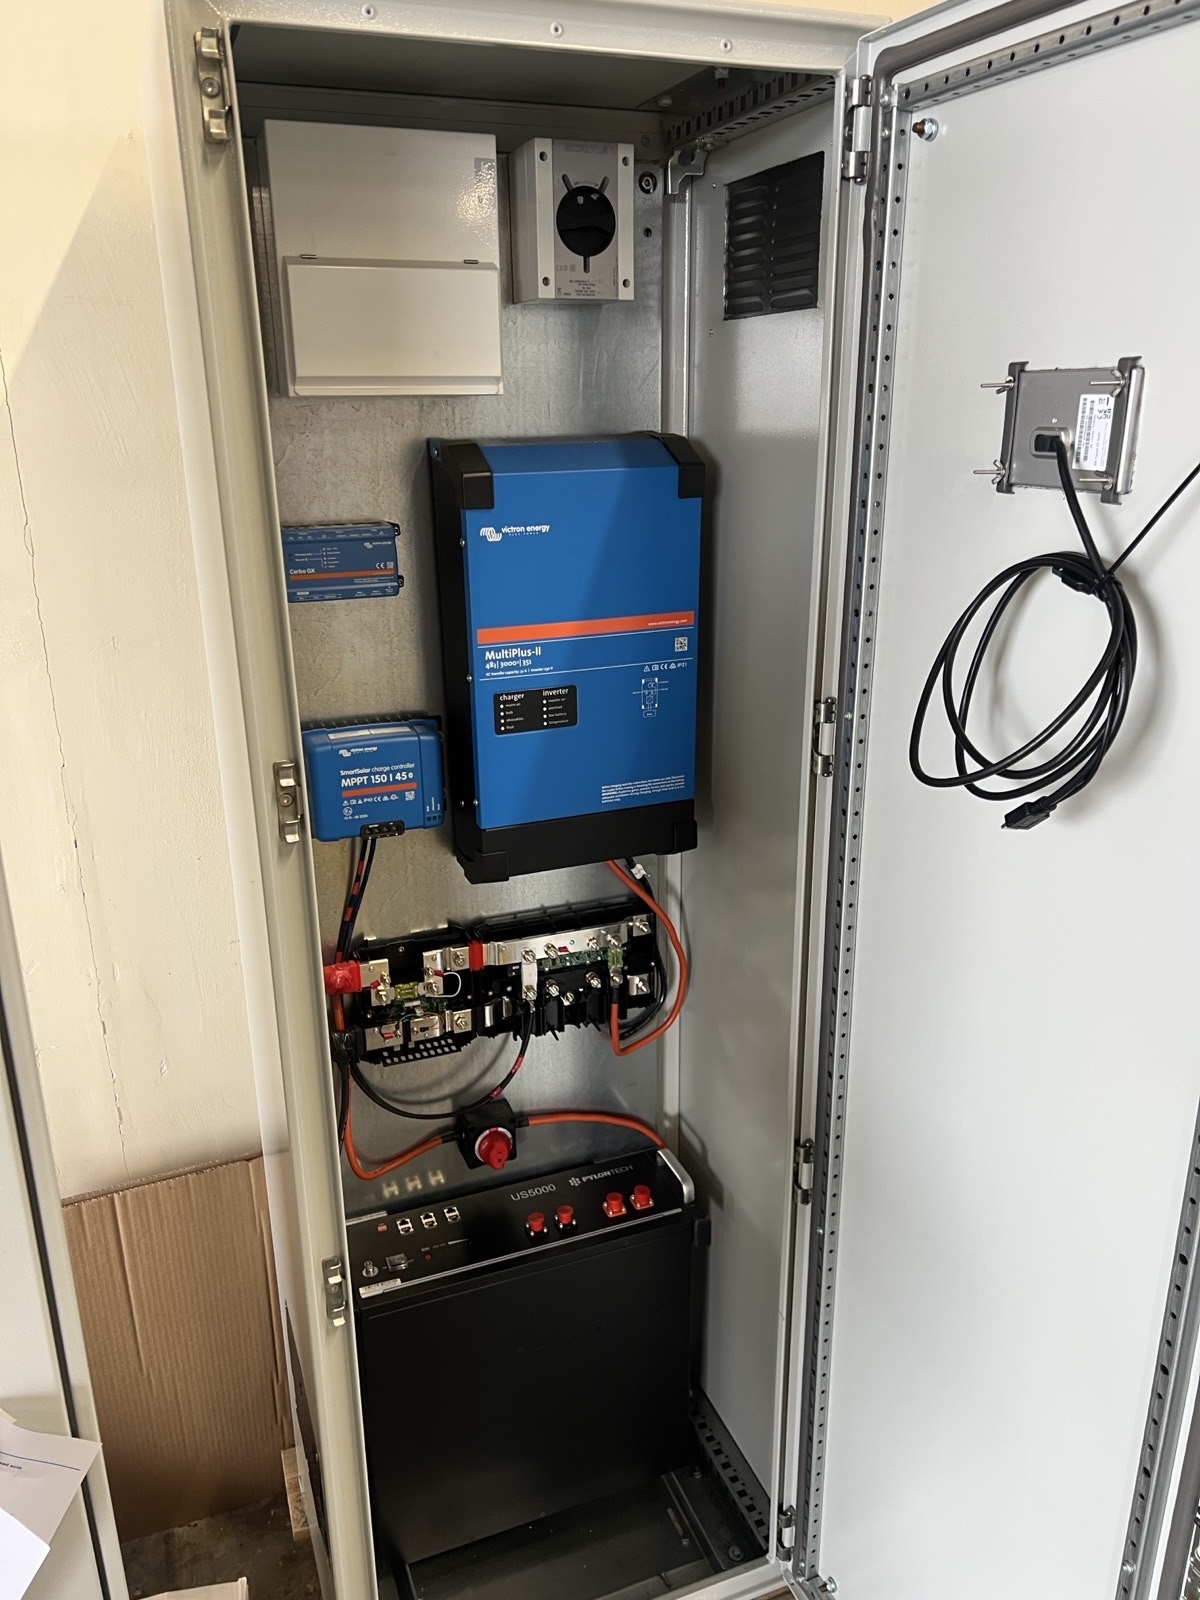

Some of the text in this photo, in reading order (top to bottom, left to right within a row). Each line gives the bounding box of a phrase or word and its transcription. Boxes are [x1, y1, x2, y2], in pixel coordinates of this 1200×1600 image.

[501, 524, 550, 533] victron energy
[499, 693, 525, 702] charger
[542, 688, 569, 697] inverter
[340, 762, 415, 776] SmartSolar charge controller
[341, 775, 368, 788] MPPT
[370, 774, 387, 784] 150
[395, 772, 407, 780] 45
[510, 1164, 634, 1201] US5000 PYLONTECH
